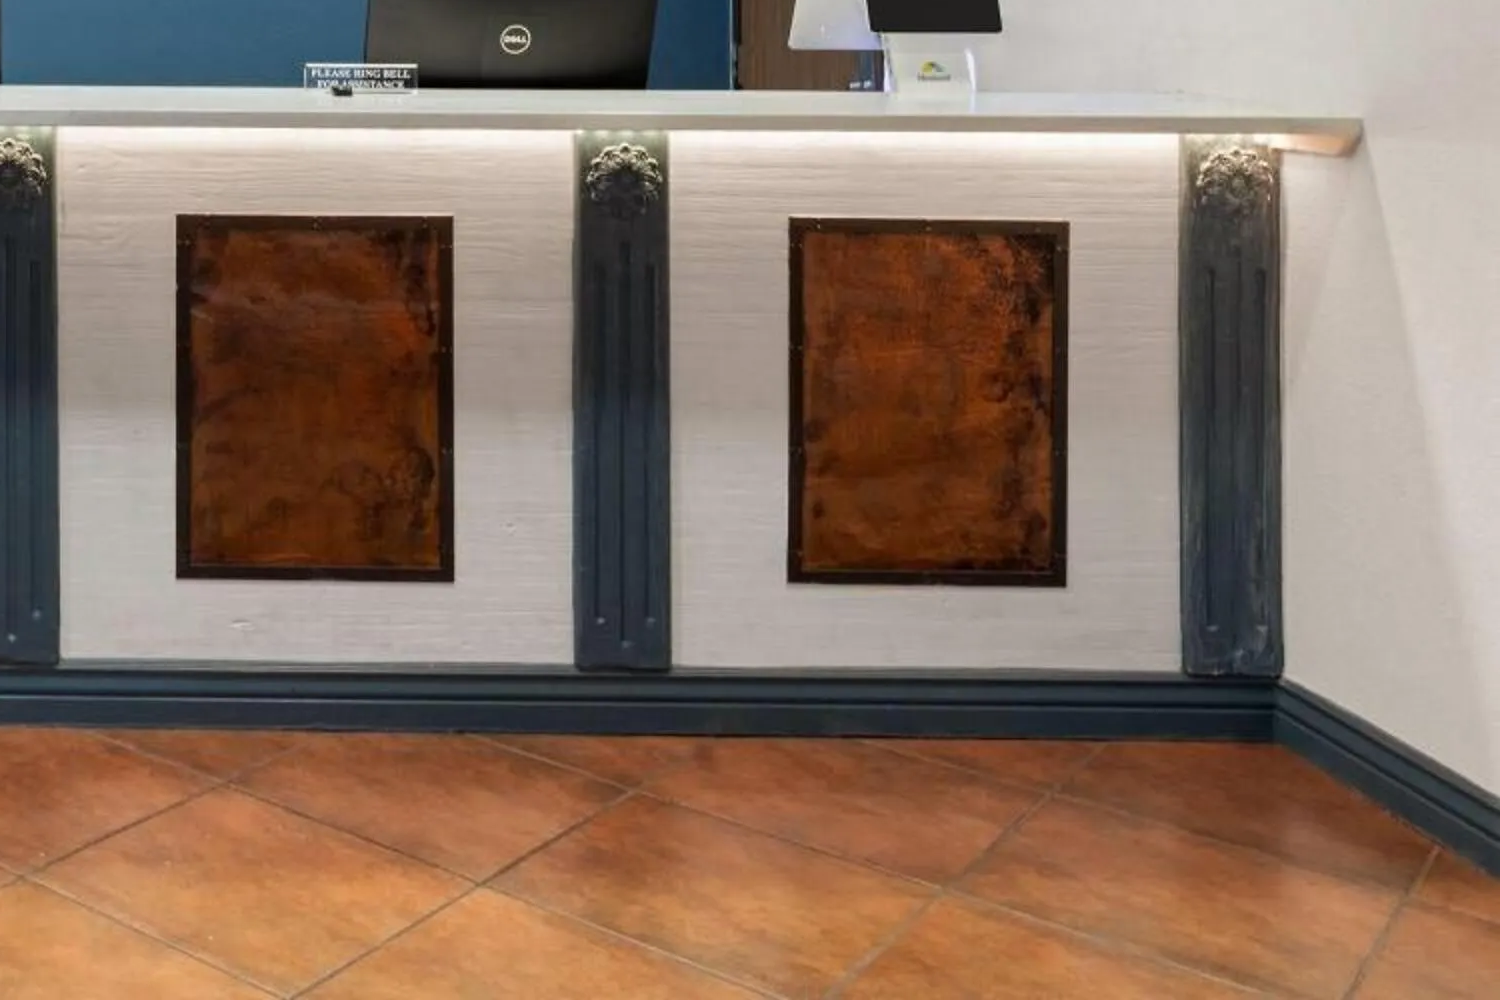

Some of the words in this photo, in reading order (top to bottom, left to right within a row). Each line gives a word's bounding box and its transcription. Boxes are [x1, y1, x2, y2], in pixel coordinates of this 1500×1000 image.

[311, 68, 351, 79] PLEASE
[353, 68, 381, 79] RING
[383, 69, 411, 79] BELL
